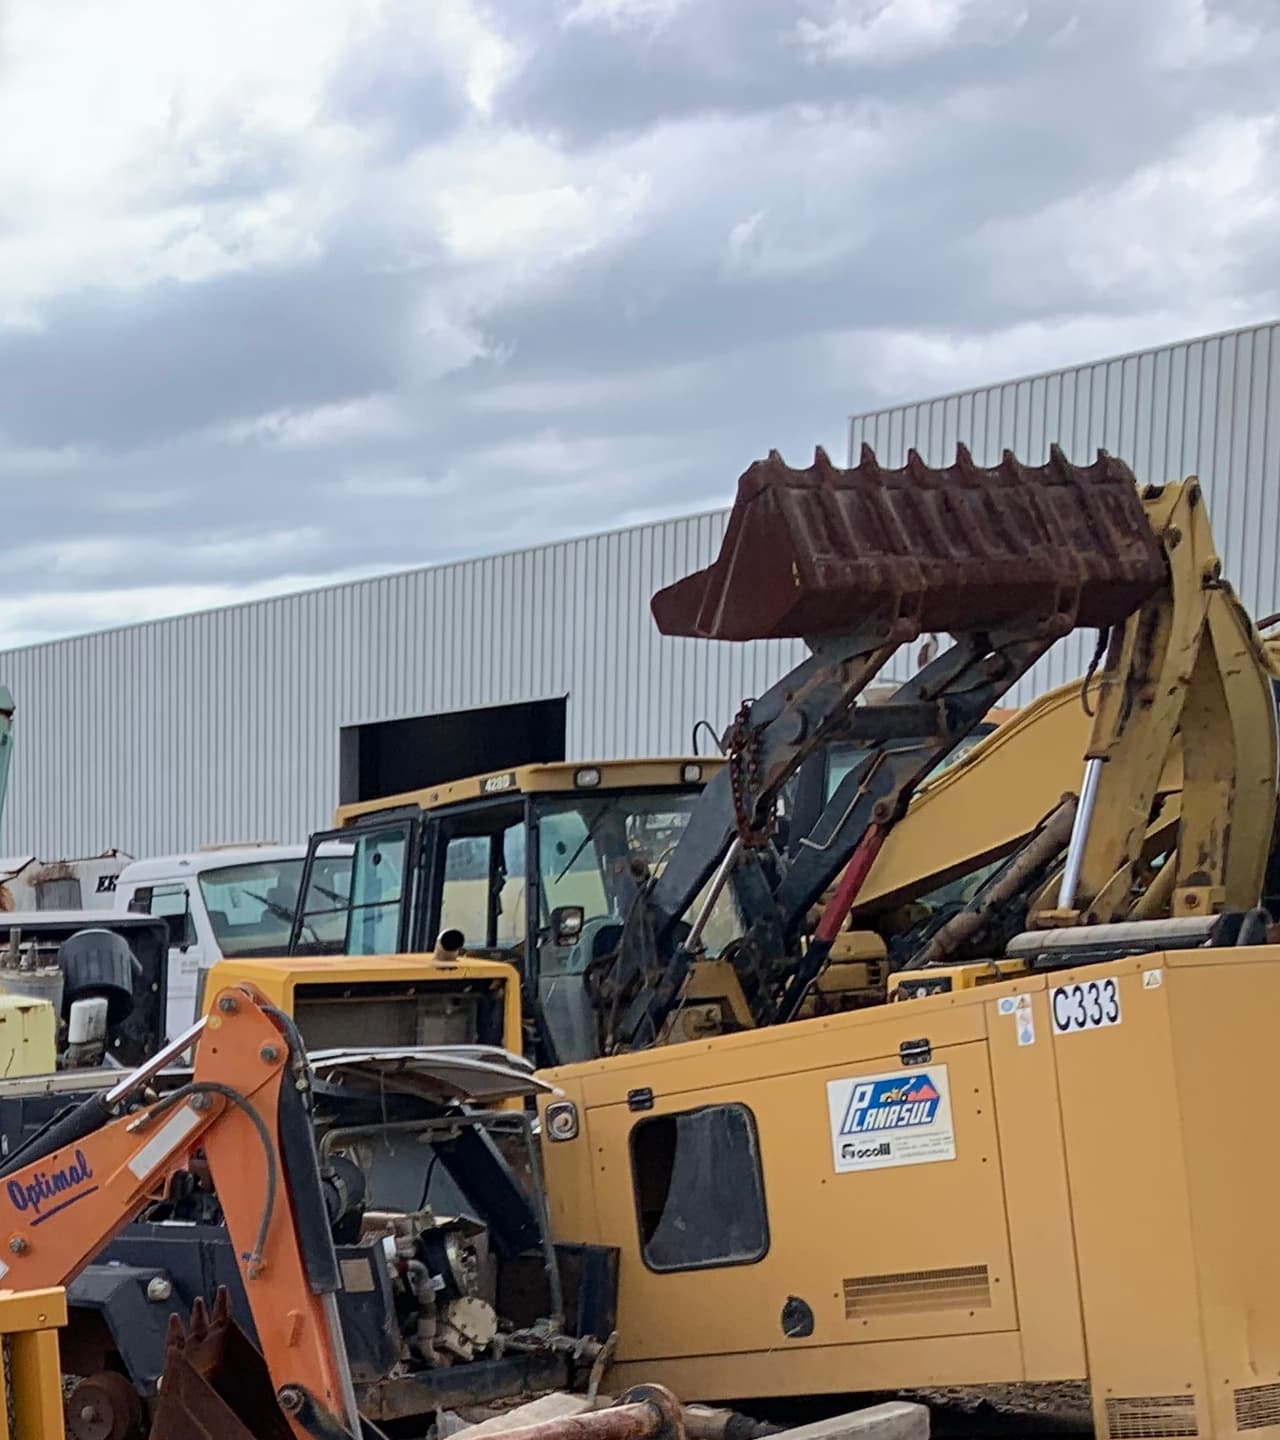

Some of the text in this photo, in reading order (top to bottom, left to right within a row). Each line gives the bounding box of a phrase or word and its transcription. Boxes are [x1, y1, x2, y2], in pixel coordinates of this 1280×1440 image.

[1052, 979, 1119, 1031] C333
[842, 1083, 933, 1134] PLANASUL
[6, 1149, 93, 1214] Optimal
